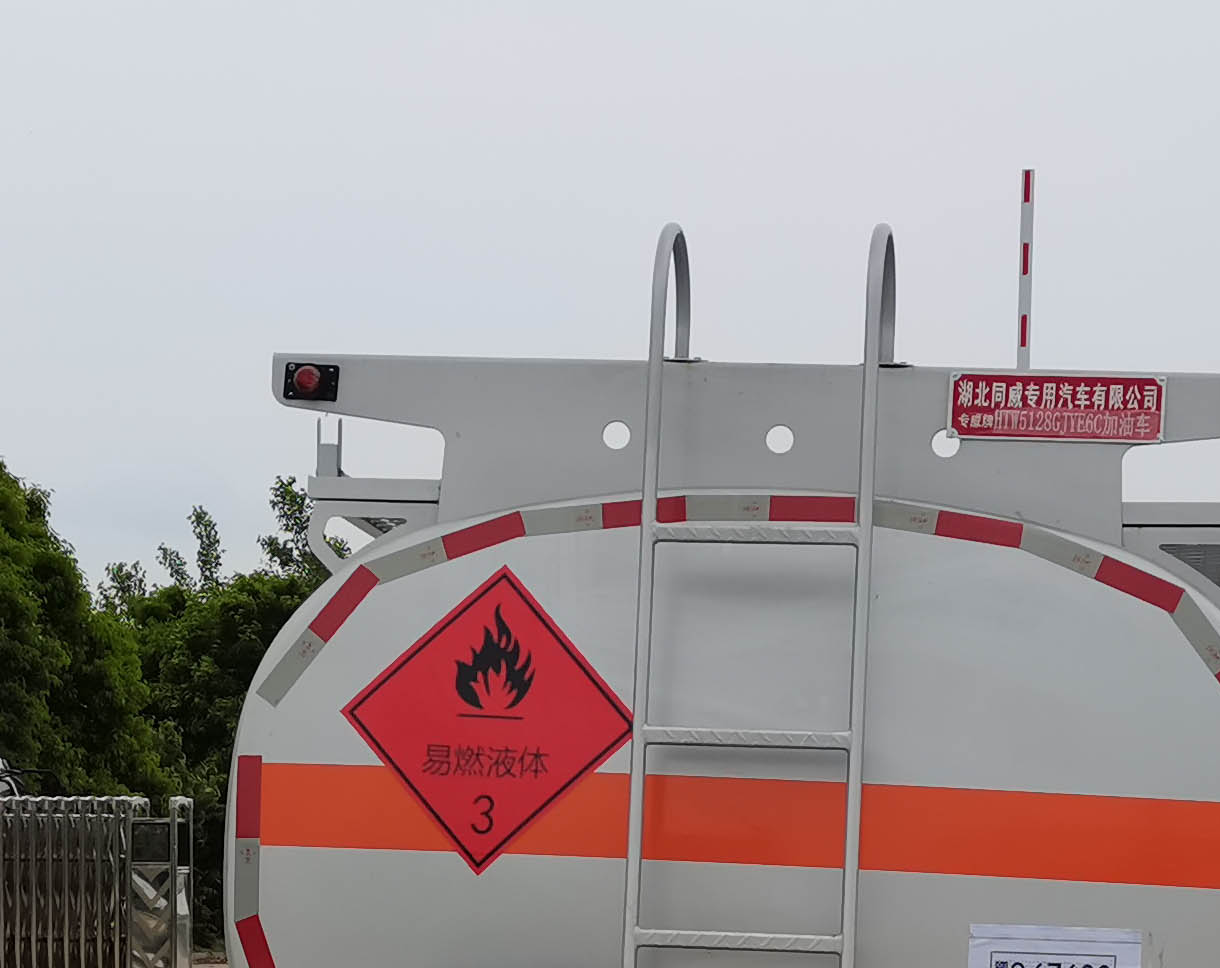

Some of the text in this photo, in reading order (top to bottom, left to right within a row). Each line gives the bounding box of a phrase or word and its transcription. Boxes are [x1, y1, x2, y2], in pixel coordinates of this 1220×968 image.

[957, 378, 1159, 411] 湖北同威专用汽车有限公司
[422, 744, 549, 779] 易燃液体
[471, 794, 495, 834] 3
